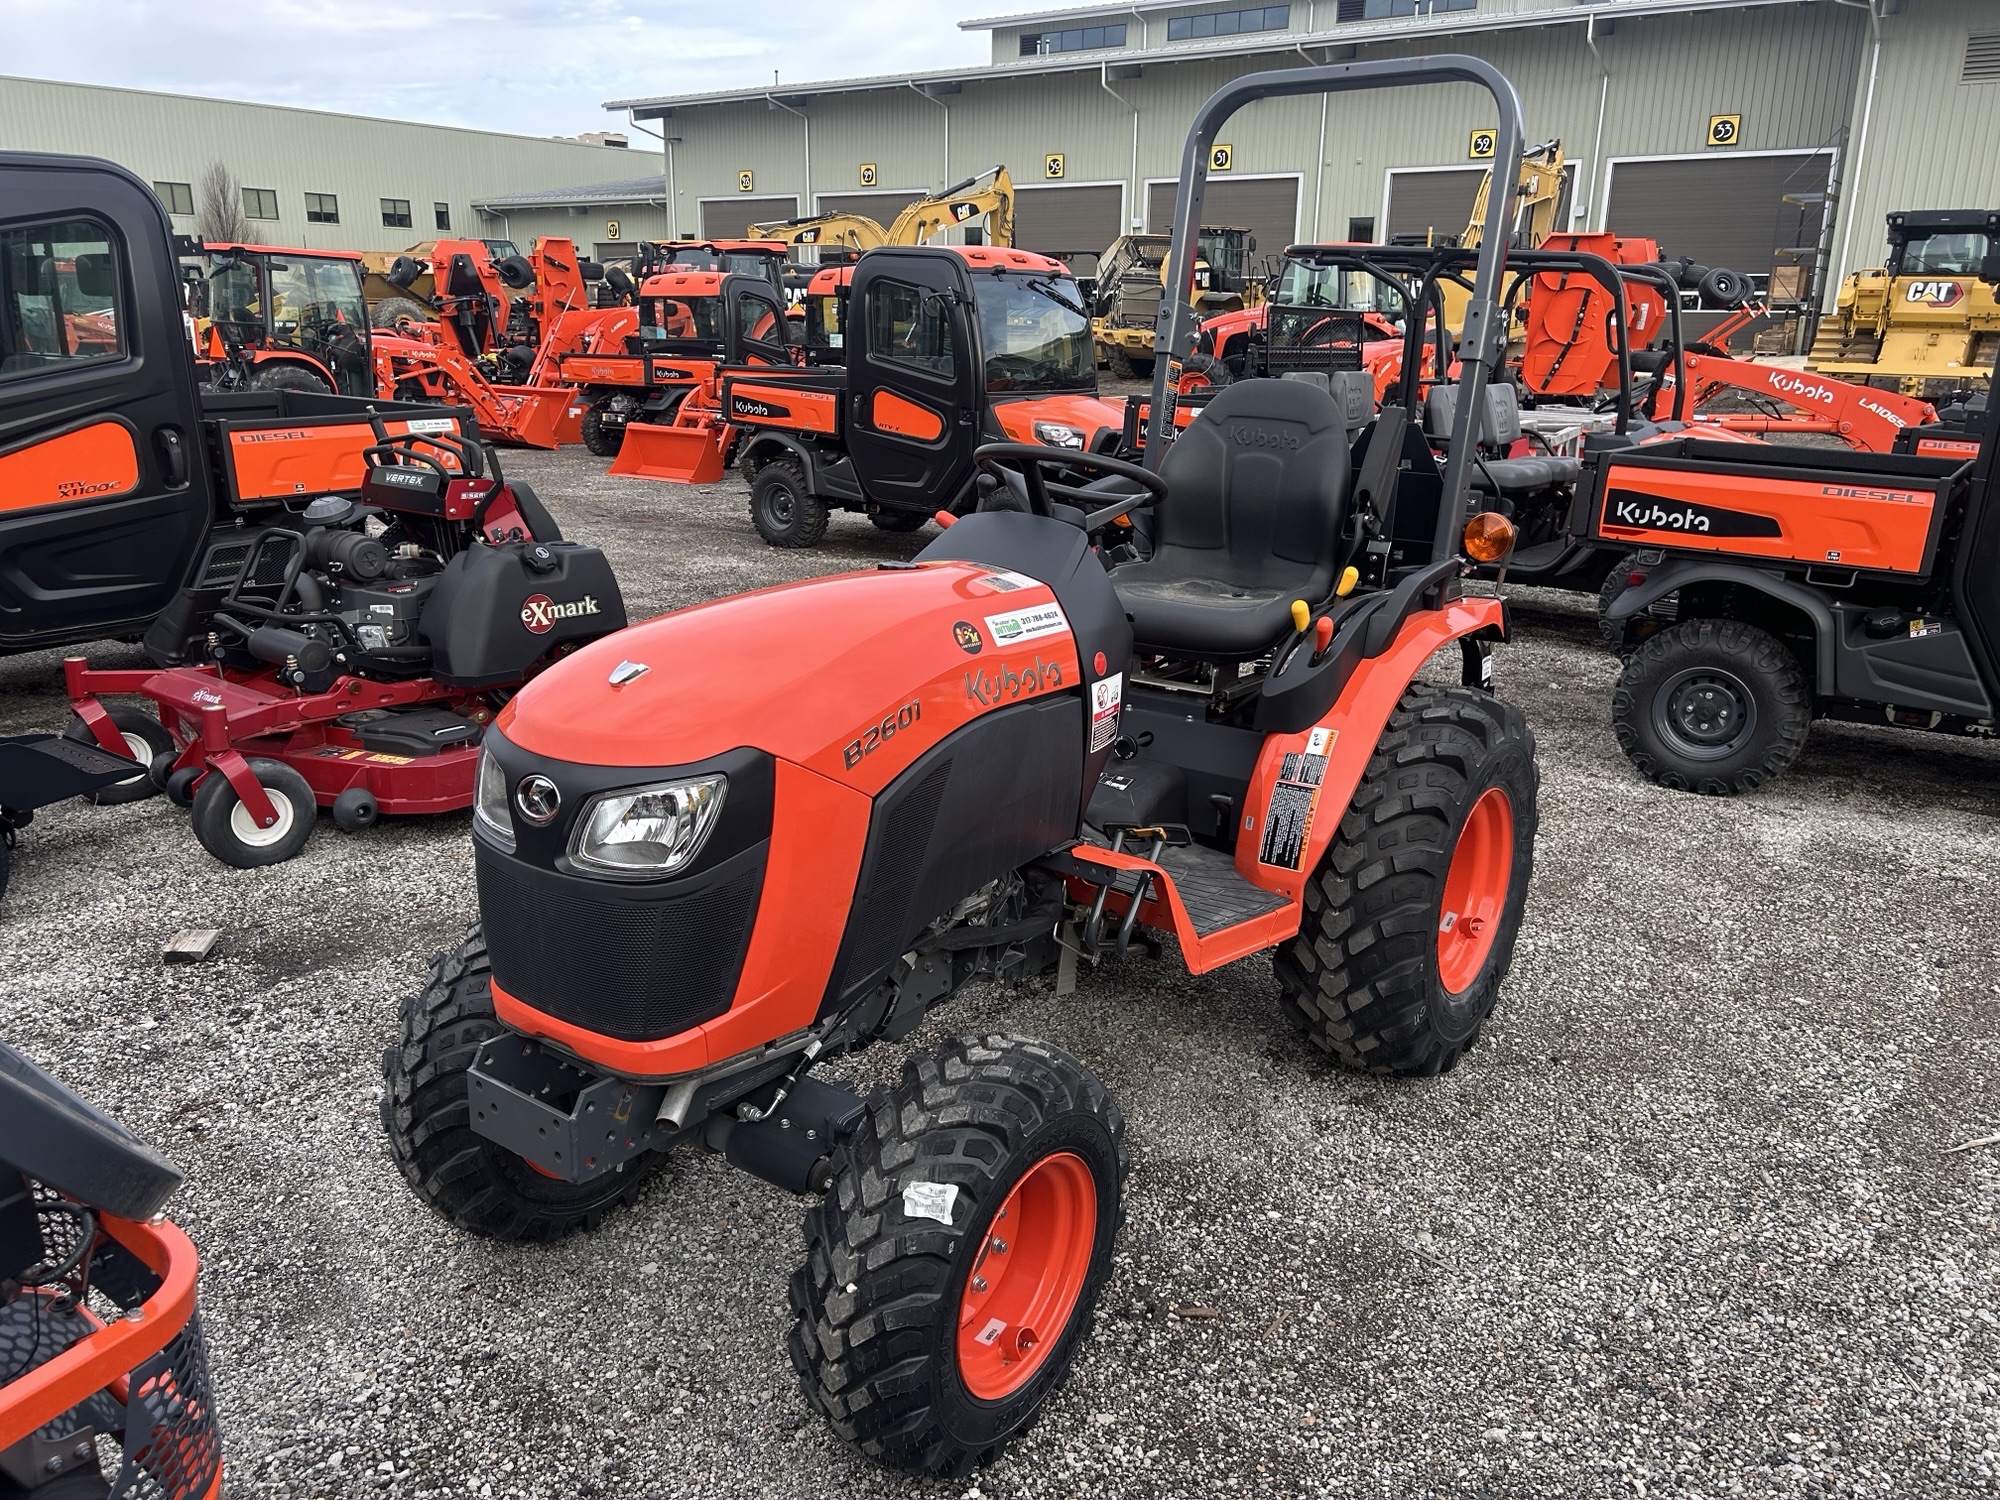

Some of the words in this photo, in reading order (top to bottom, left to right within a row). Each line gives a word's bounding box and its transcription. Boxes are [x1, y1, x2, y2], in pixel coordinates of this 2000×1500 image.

[1715, 122, 1733, 138] 33
[1475, 138, 1490, 152] 32
[1216, 151, 1227, 166] 31
[1049, 161, 1062, 173] 30
[741, 175, 751, 187] 28
[863, 169, 873, 182] 29
[956, 203, 970, 221] CAT
[802, 231, 815, 243] CAT
[1906, 281, 1953, 302] CAT
[656, 370, 680, 379] Kubota
[1768, 371, 1835, 404] Kubota
[735, 400, 768, 416] Kubota
[1858, 397, 1908, 429] LA1065
[239, 431, 315, 443] DIESEL
[1228, 425, 1300, 450] Kubota
[1922, 440, 1980, 451] DIESE
[58, 480, 88, 490] RTV
[385, 472, 424, 486] VERTEX
[59, 480, 122, 498] X1100C
[1822, 486, 1925, 505] DIESEL
[1616, 500, 1710, 533] Kubota
[964, 655, 1063, 706] Kubota
[843, 697, 921, 771] B2601
